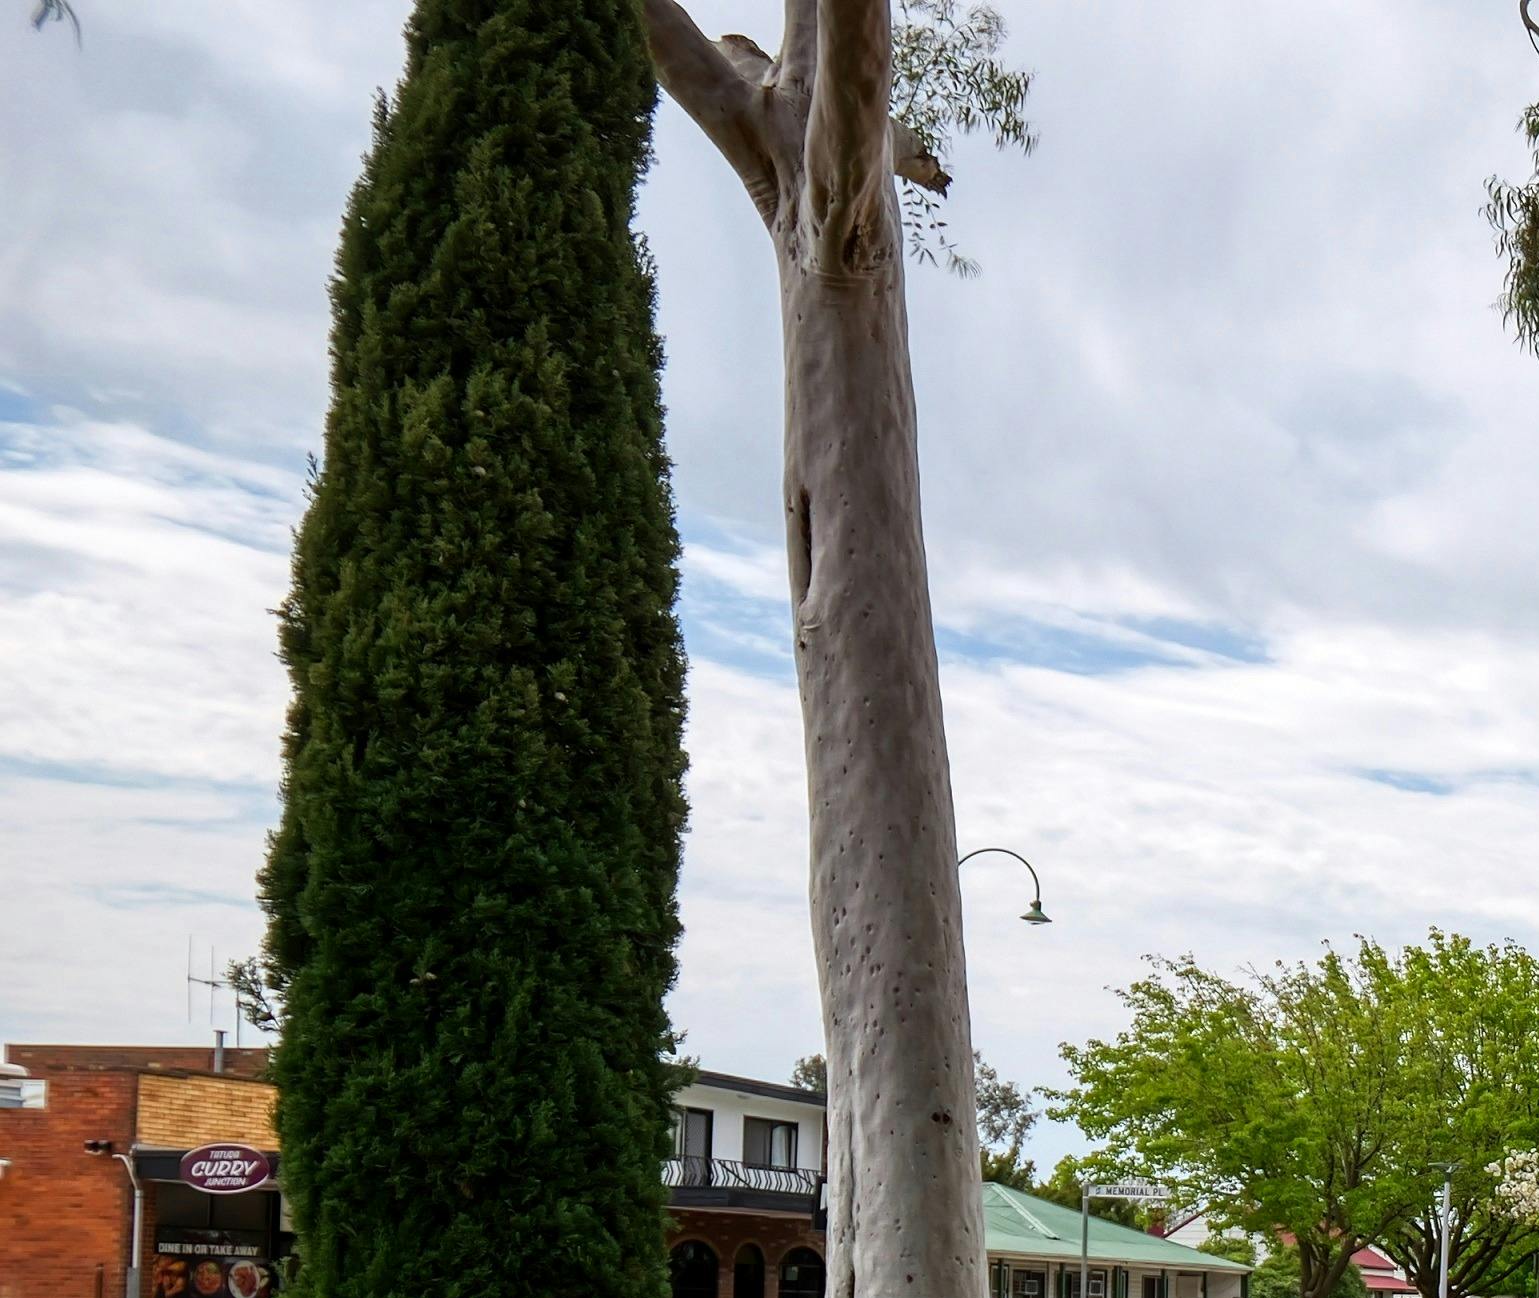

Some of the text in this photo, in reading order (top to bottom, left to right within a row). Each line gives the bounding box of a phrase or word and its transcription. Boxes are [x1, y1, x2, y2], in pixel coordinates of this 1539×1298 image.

[191, 1160, 257, 1176] CURRY
[204, 1177, 247, 1187] JUNCTION
[1106, 1187, 1163, 1196] MEMORIAL PL
[158, 1242, 258, 1256] DINE IN OR TAKE AWAY
